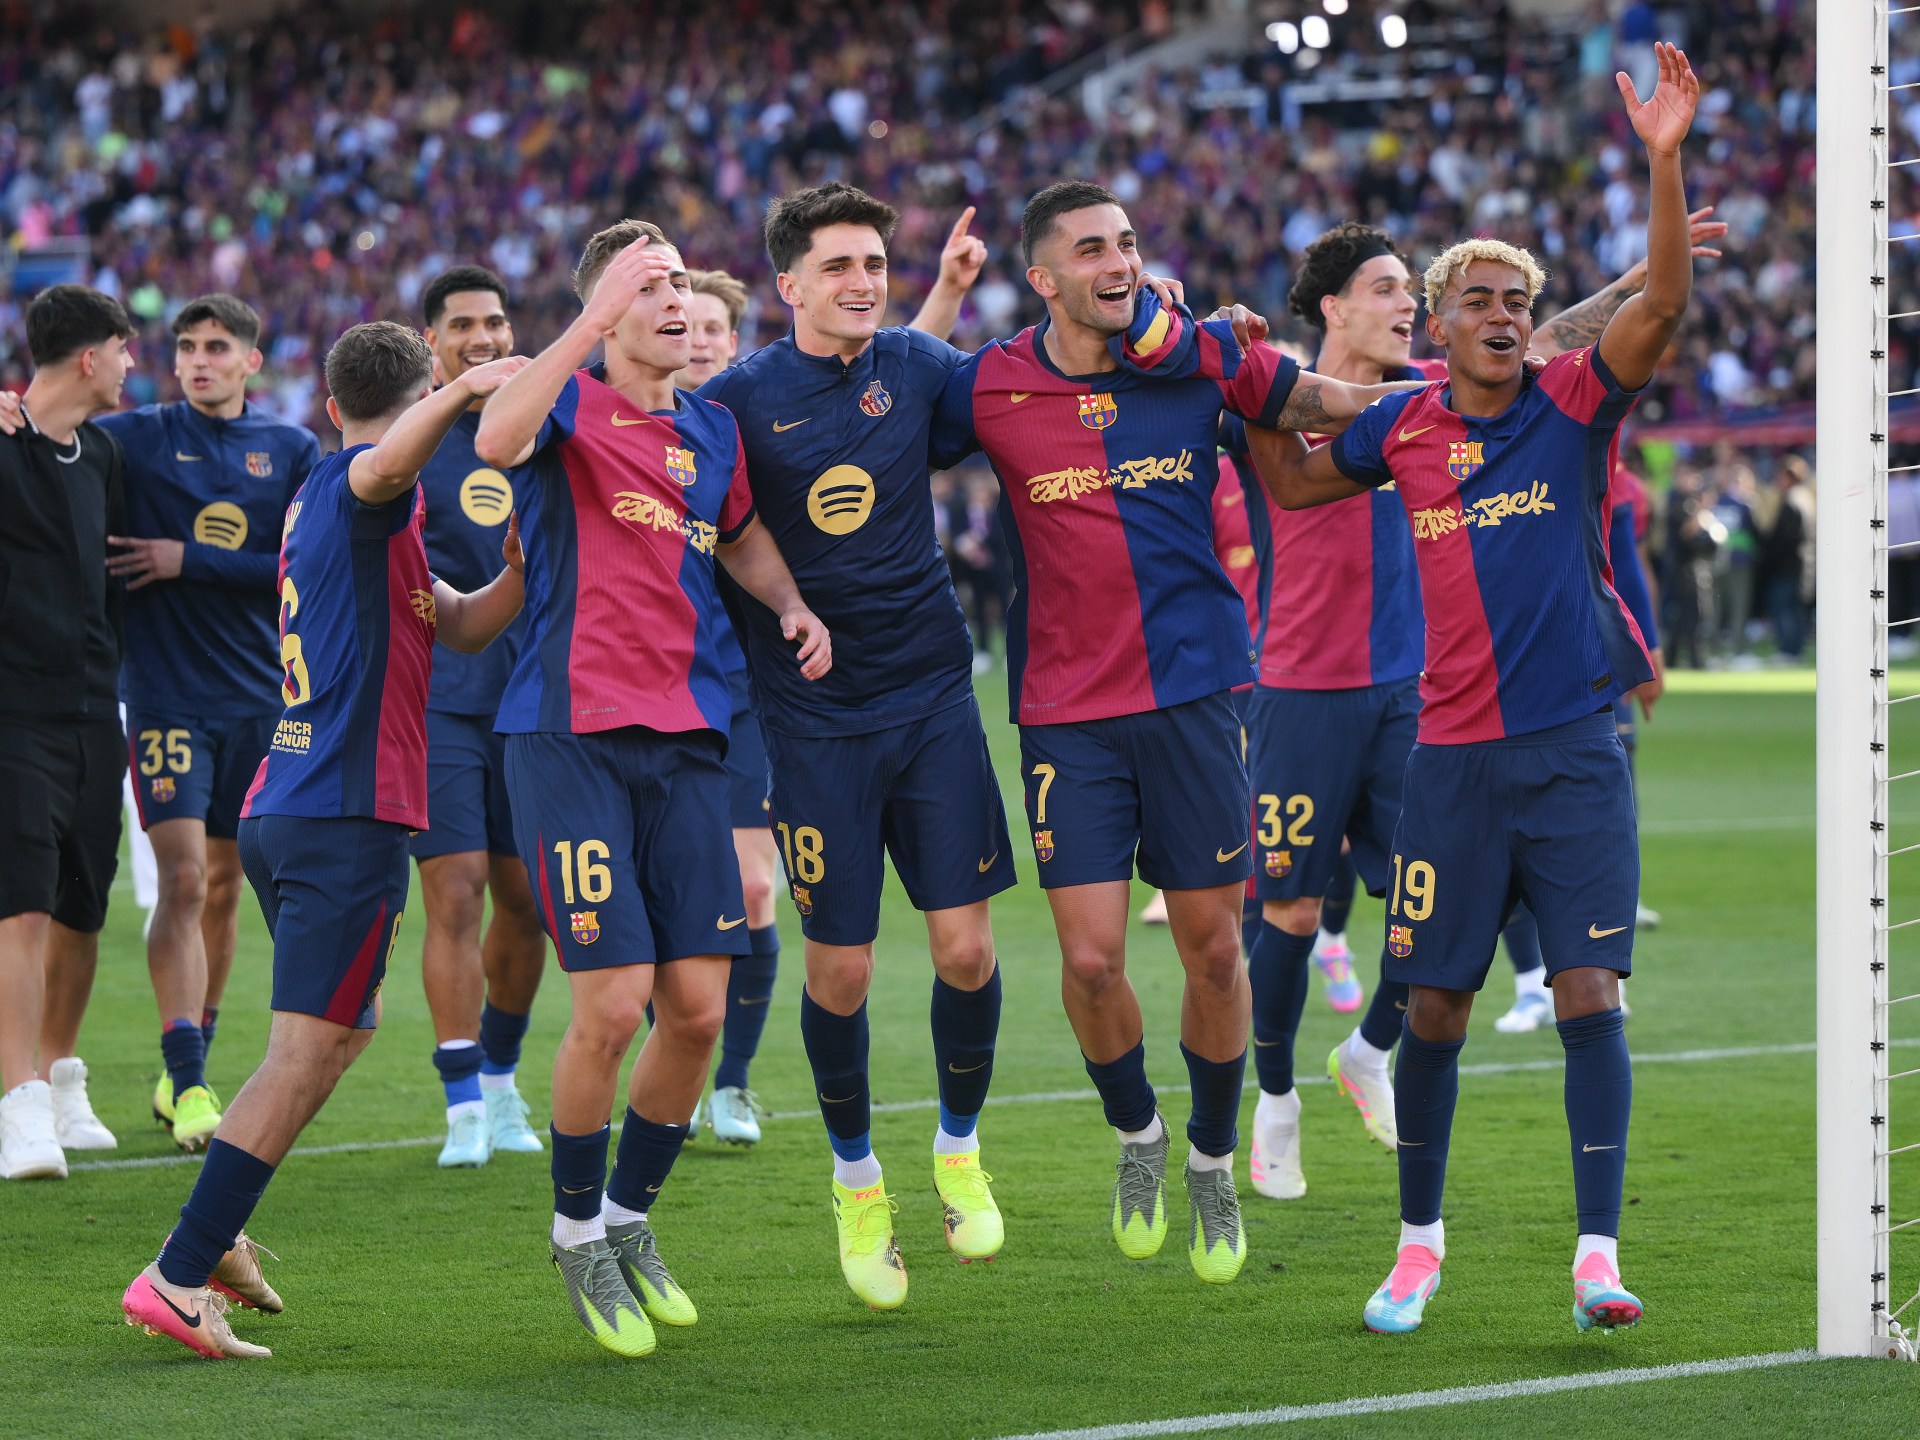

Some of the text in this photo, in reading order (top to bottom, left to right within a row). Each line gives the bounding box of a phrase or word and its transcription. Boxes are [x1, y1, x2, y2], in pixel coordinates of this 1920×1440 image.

[1089, 405, 1106, 413] FCB
[1118, 448, 1194, 490] Jack
[1472, 480, 1556, 528] Jack
[281, 576, 310, 708] 6
[140, 728, 192, 776] 35
[272, 731, 311, 749] CNUR
[1031, 763, 1056, 824] 7
[1257, 794, 1315, 847] 32
[553, 839, 612, 904] 16
[776, 821, 825, 884] 18
[1390, 854, 1436, 921] 19
